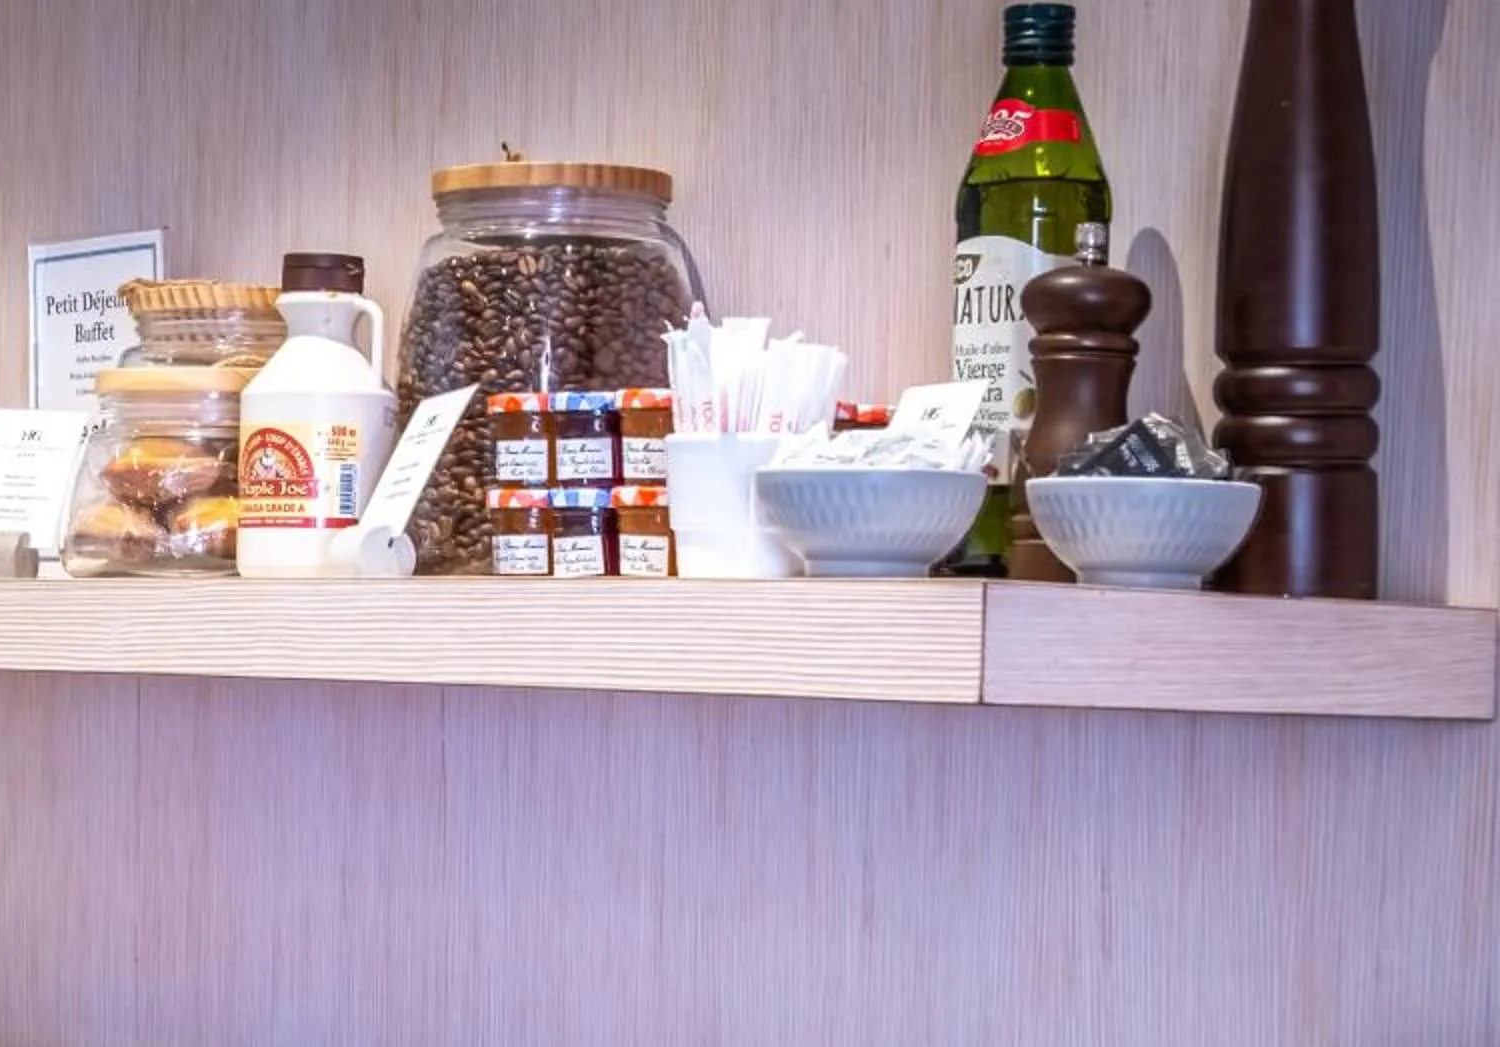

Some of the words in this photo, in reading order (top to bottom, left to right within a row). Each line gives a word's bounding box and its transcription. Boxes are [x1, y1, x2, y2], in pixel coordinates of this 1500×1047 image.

[46, 295, 77, 315] Petit
[954, 285, 1026, 324] ATUR
[75, 321, 115, 343] Buffet
[955, 357, 1005, 384] Vierge
